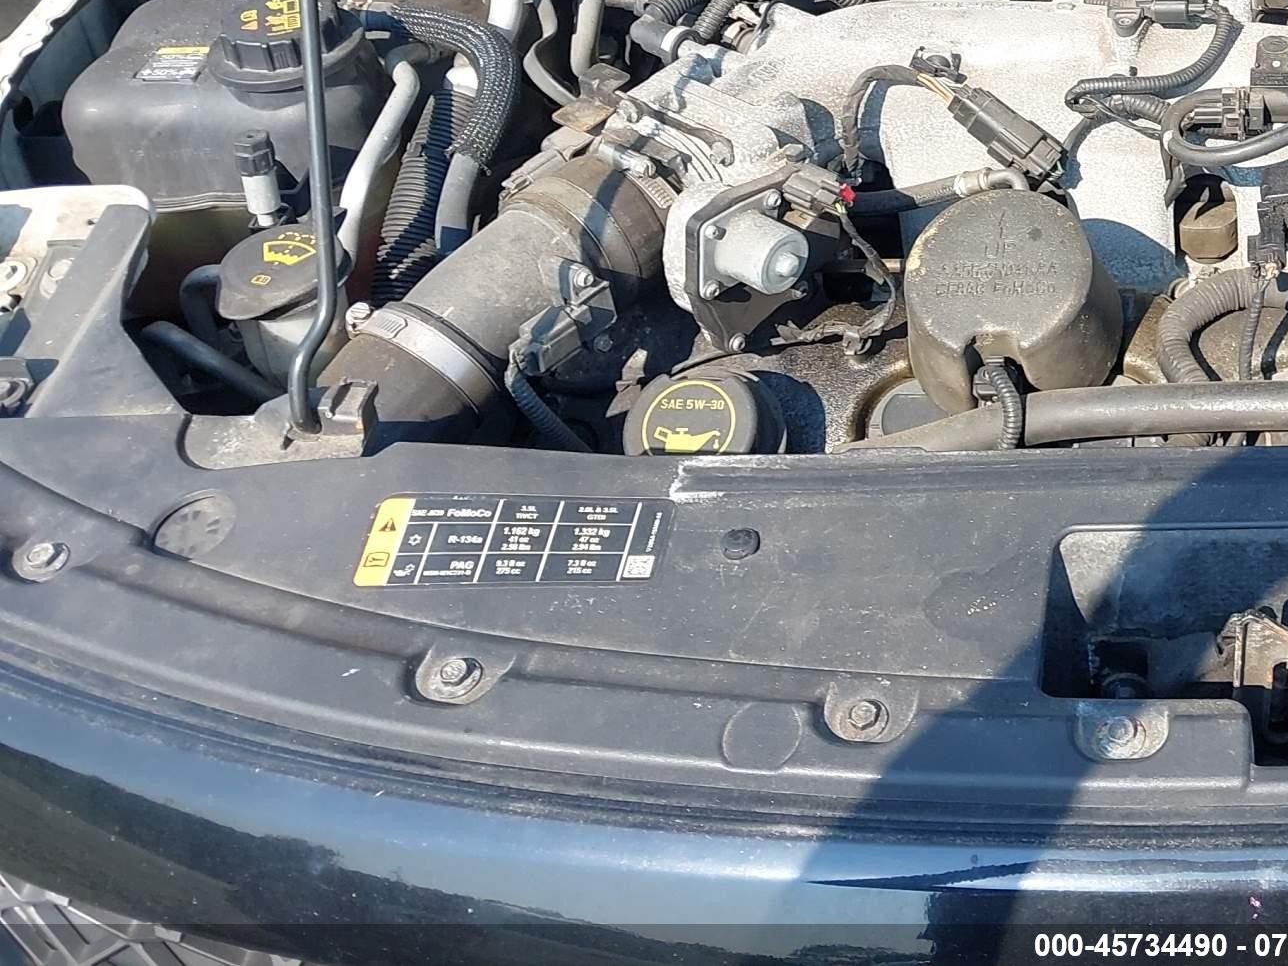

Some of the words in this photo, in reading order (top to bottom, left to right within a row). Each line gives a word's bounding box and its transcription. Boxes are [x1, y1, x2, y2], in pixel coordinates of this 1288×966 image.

[660, 398, 684, 410] SAE
[685, 398, 725, 410] 5W-30
[446, 508, 493, 518] FoMoCo
[528, 527, 541, 538] kg
[598, 528, 611, 538] kg
[447, 534, 484, 544] R-134a
[449, 560, 475, 570] PAG
